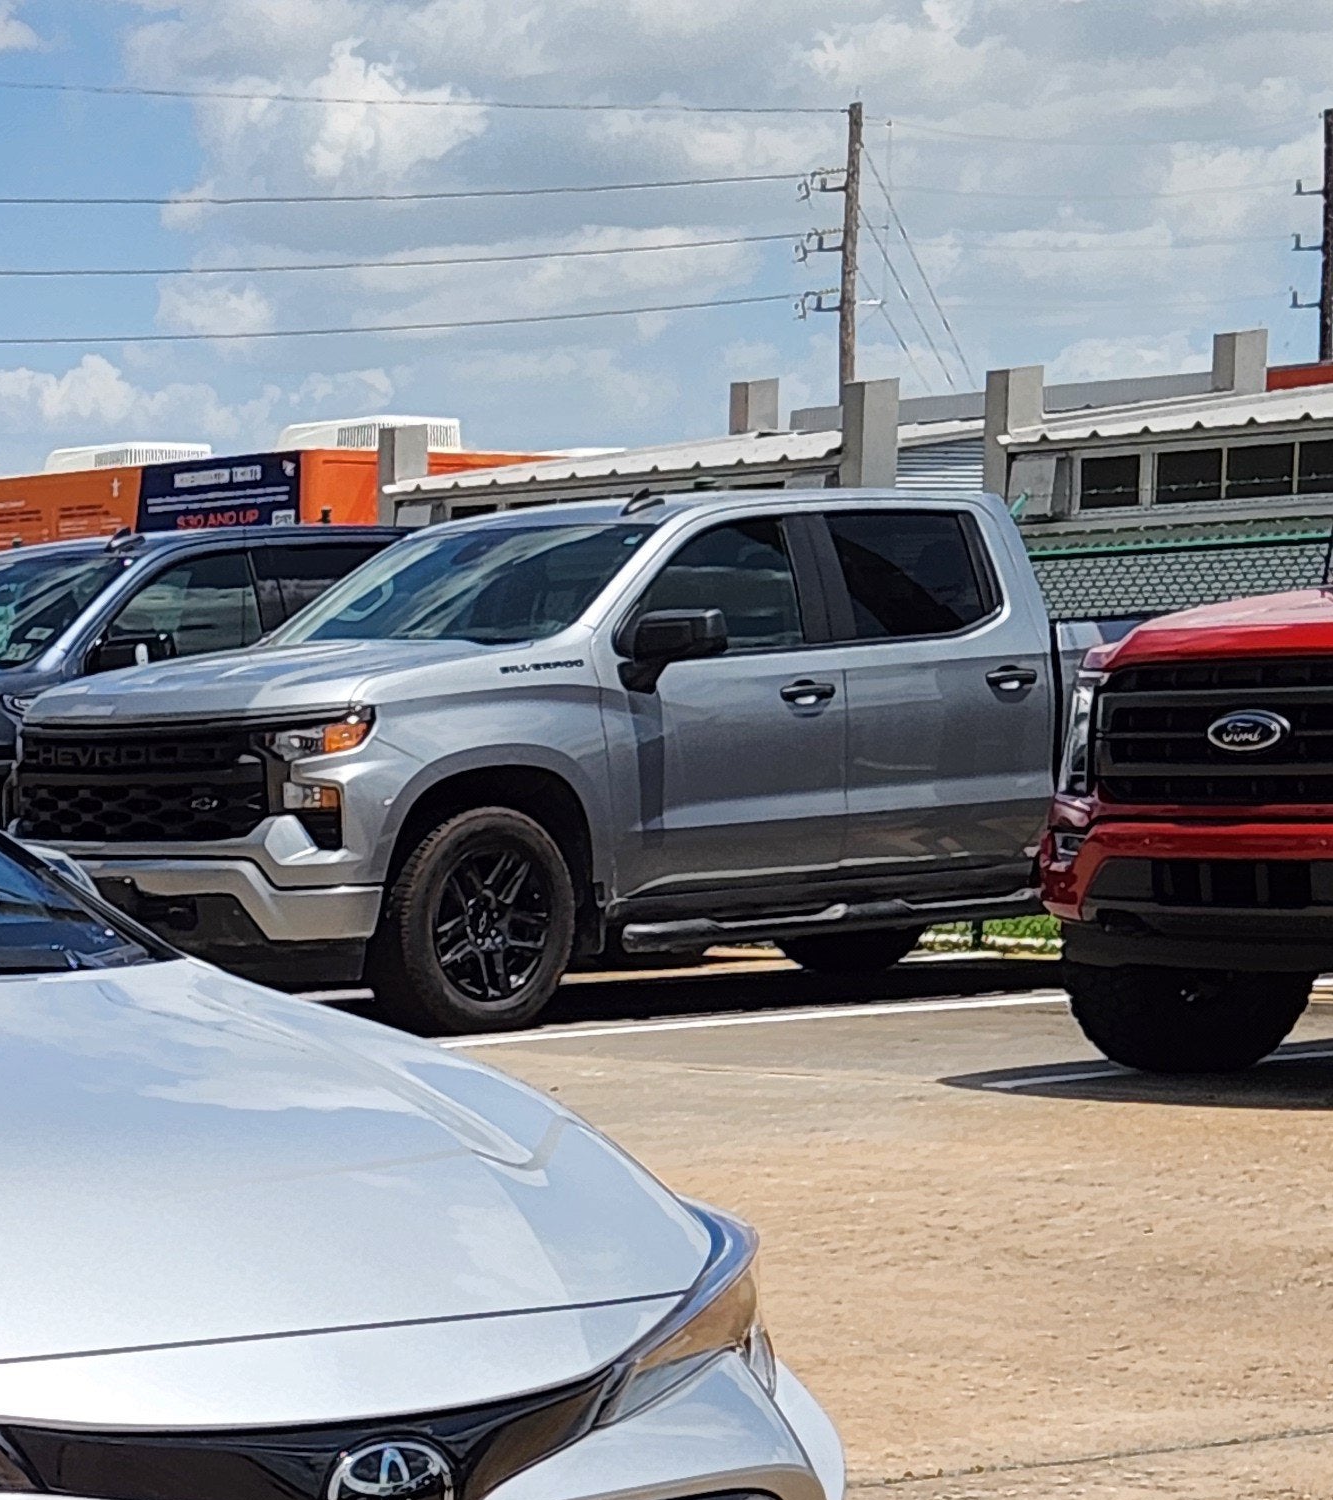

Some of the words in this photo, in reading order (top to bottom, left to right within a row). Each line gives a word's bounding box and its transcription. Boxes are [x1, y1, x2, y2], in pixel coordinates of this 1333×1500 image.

[207, 511, 237, 526] AND
[239, 508, 260, 524] UP
[1222, 722, 1263, 743] Ford
